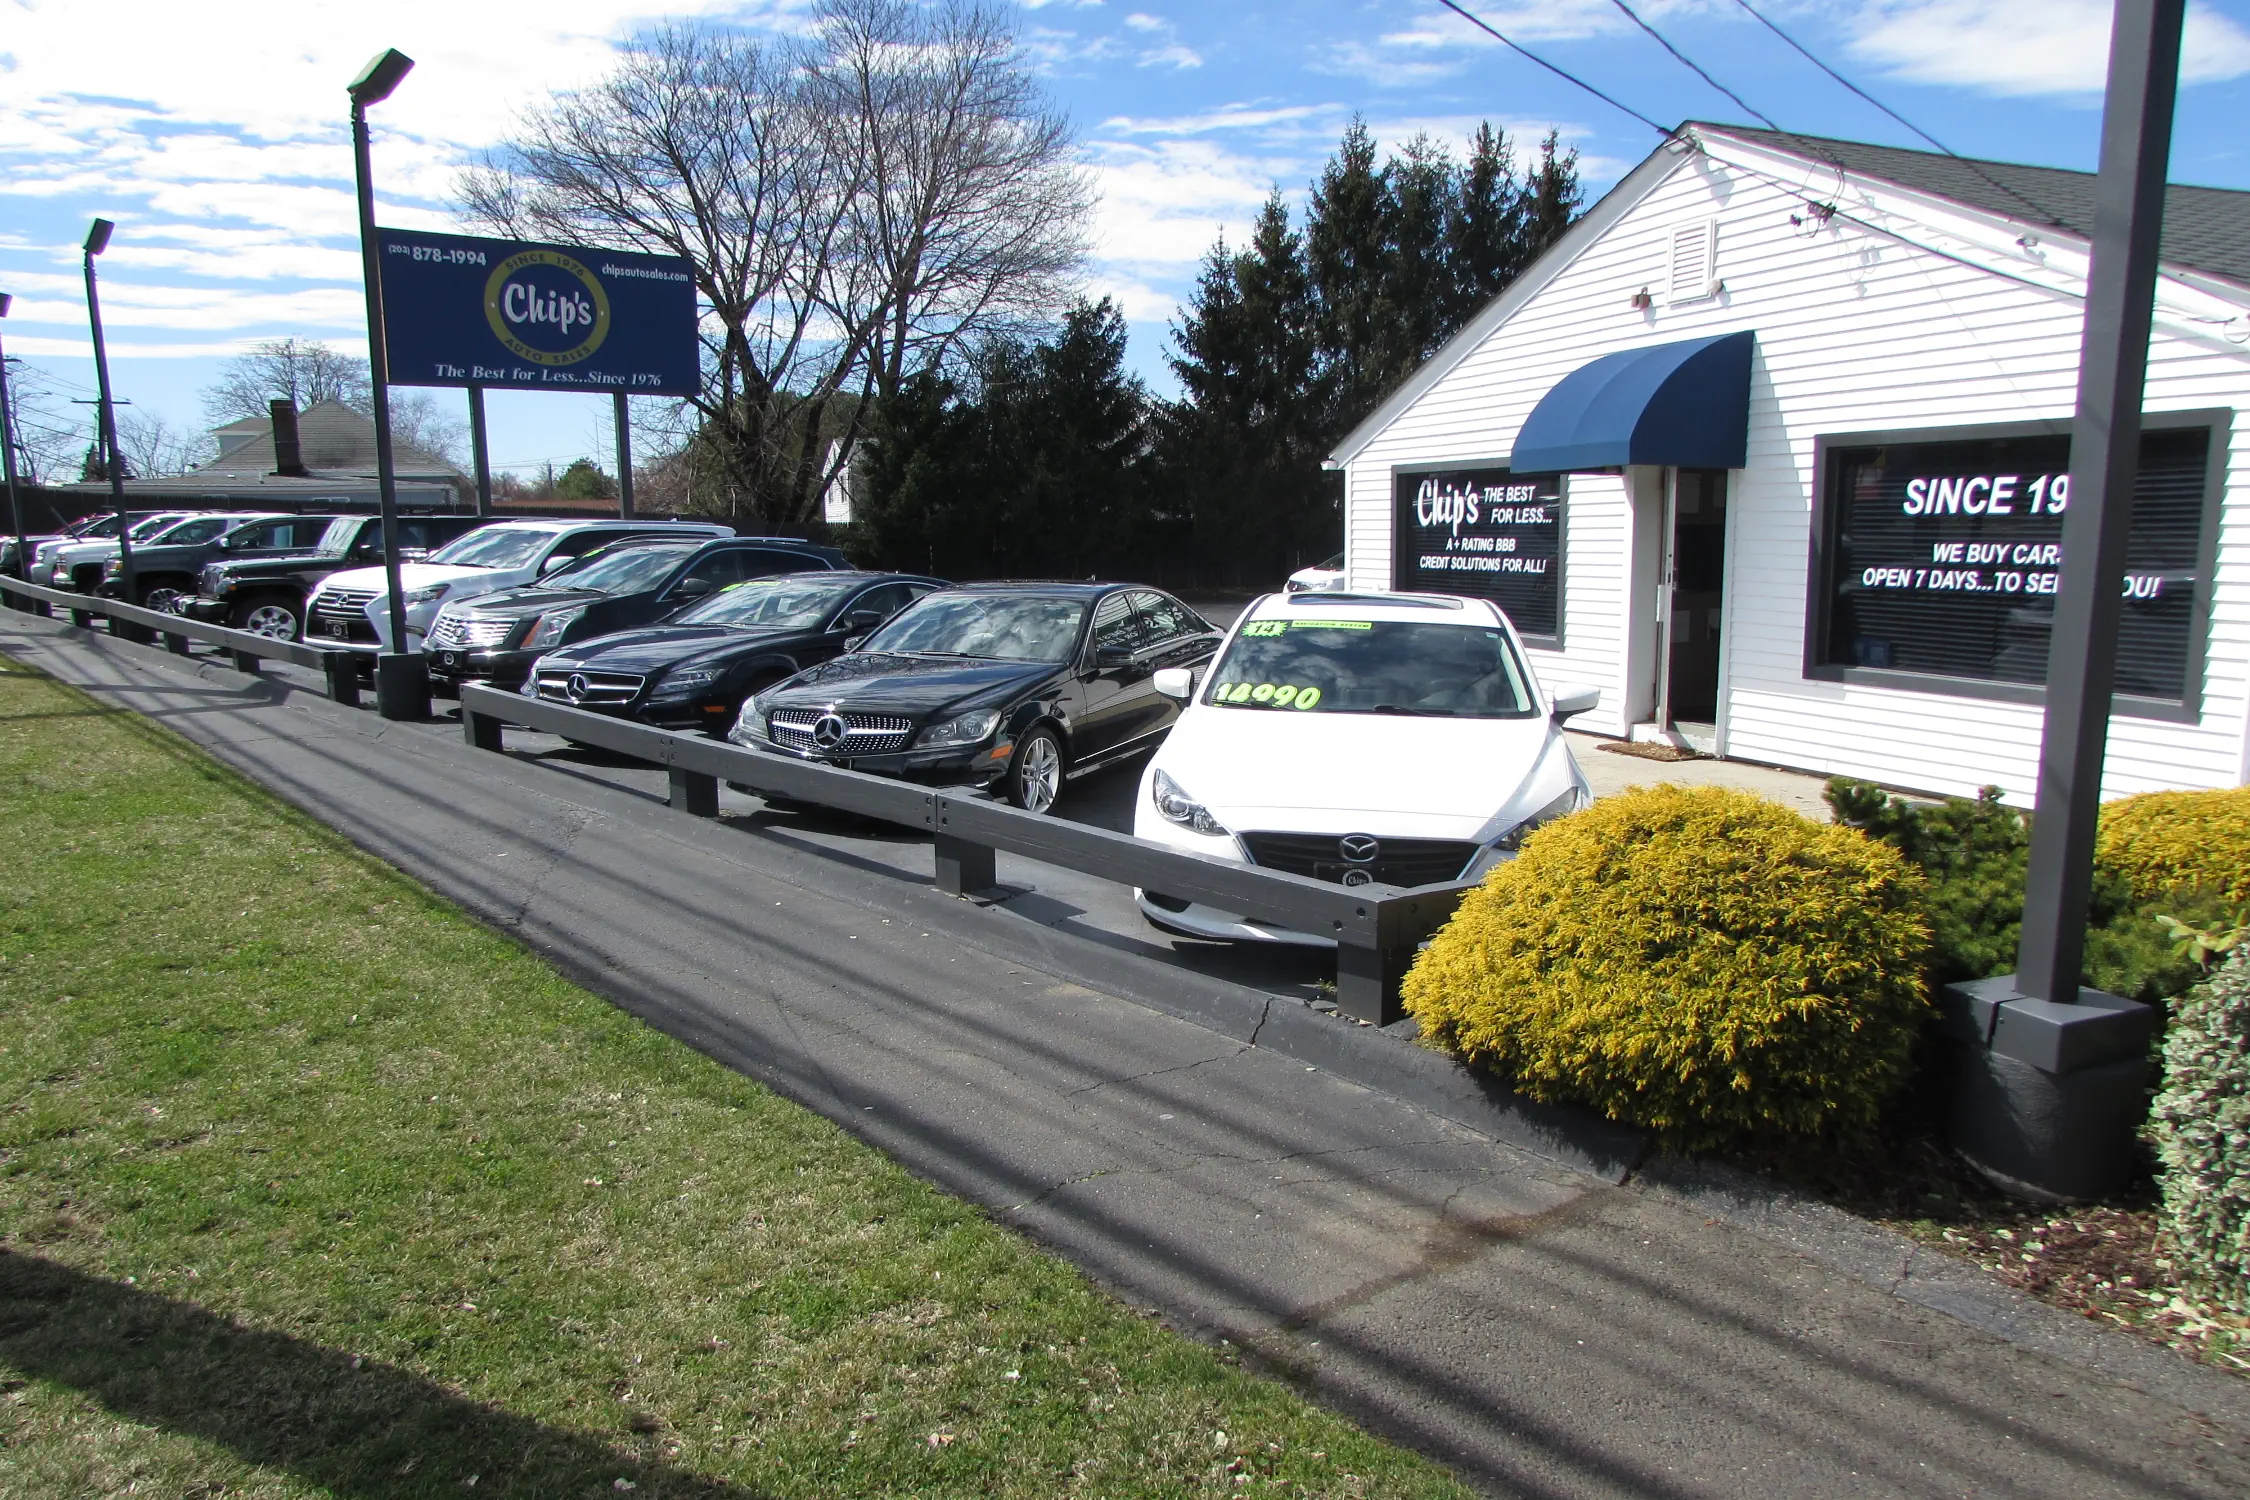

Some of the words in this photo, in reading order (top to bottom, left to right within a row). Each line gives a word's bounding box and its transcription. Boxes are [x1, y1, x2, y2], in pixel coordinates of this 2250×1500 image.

[388, 244, 411, 256] (203)
[412, 246, 487, 266] 878-1994
[505, 253, 546, 271] SINCE
[556, 256, 585, 277] 1976
[601, 263, 689, 282] chipsautosales.com
[504, 283, 593, 335] Chip's
[503, 338, 543, 362] AUTO
[553, 346, 592, 364] SALES
[435, 364, 466, 379] The
[472, 365, 506, 380] Best
[512, 367, 535, 381] for
[631, 374, 662, 387] 1976
[1484, 487, 1505, 504] THE
[1506, 485, 1536, 503] BEST
[1902, 474, 2018, 516] SINCE
[2027, 473, 2070, 515] 19
[1417, 478, 1479, 537] Chip's
[1490, 508, 1514, 524] FOR
[1515, 507, 1553, 524] LESS...
[1461, 538, 1494, 552] RATING
[1495, 538, 1516, 552] BBB
[1932, 543, 1963, 564] WE
[1966, 543, 2011, 565] BUY
[2012, 544, 2062, 565] CAR
[1419, 555, 1451, 570] CREDIT
[1450, 556, 1501, 571] SOLUTIONS
[1502, 558, 1523, 572] FOR
[1523, 559, 1547, 574] ALL!
[1862, 568, 1911, 588] OPEN
[1914, 570, 1926, 588] 7
[2121, 576, 2161, 599] OU!
[1255, 624, 1276, 634] 14
[1214, 682, 1321, 710] 14990
